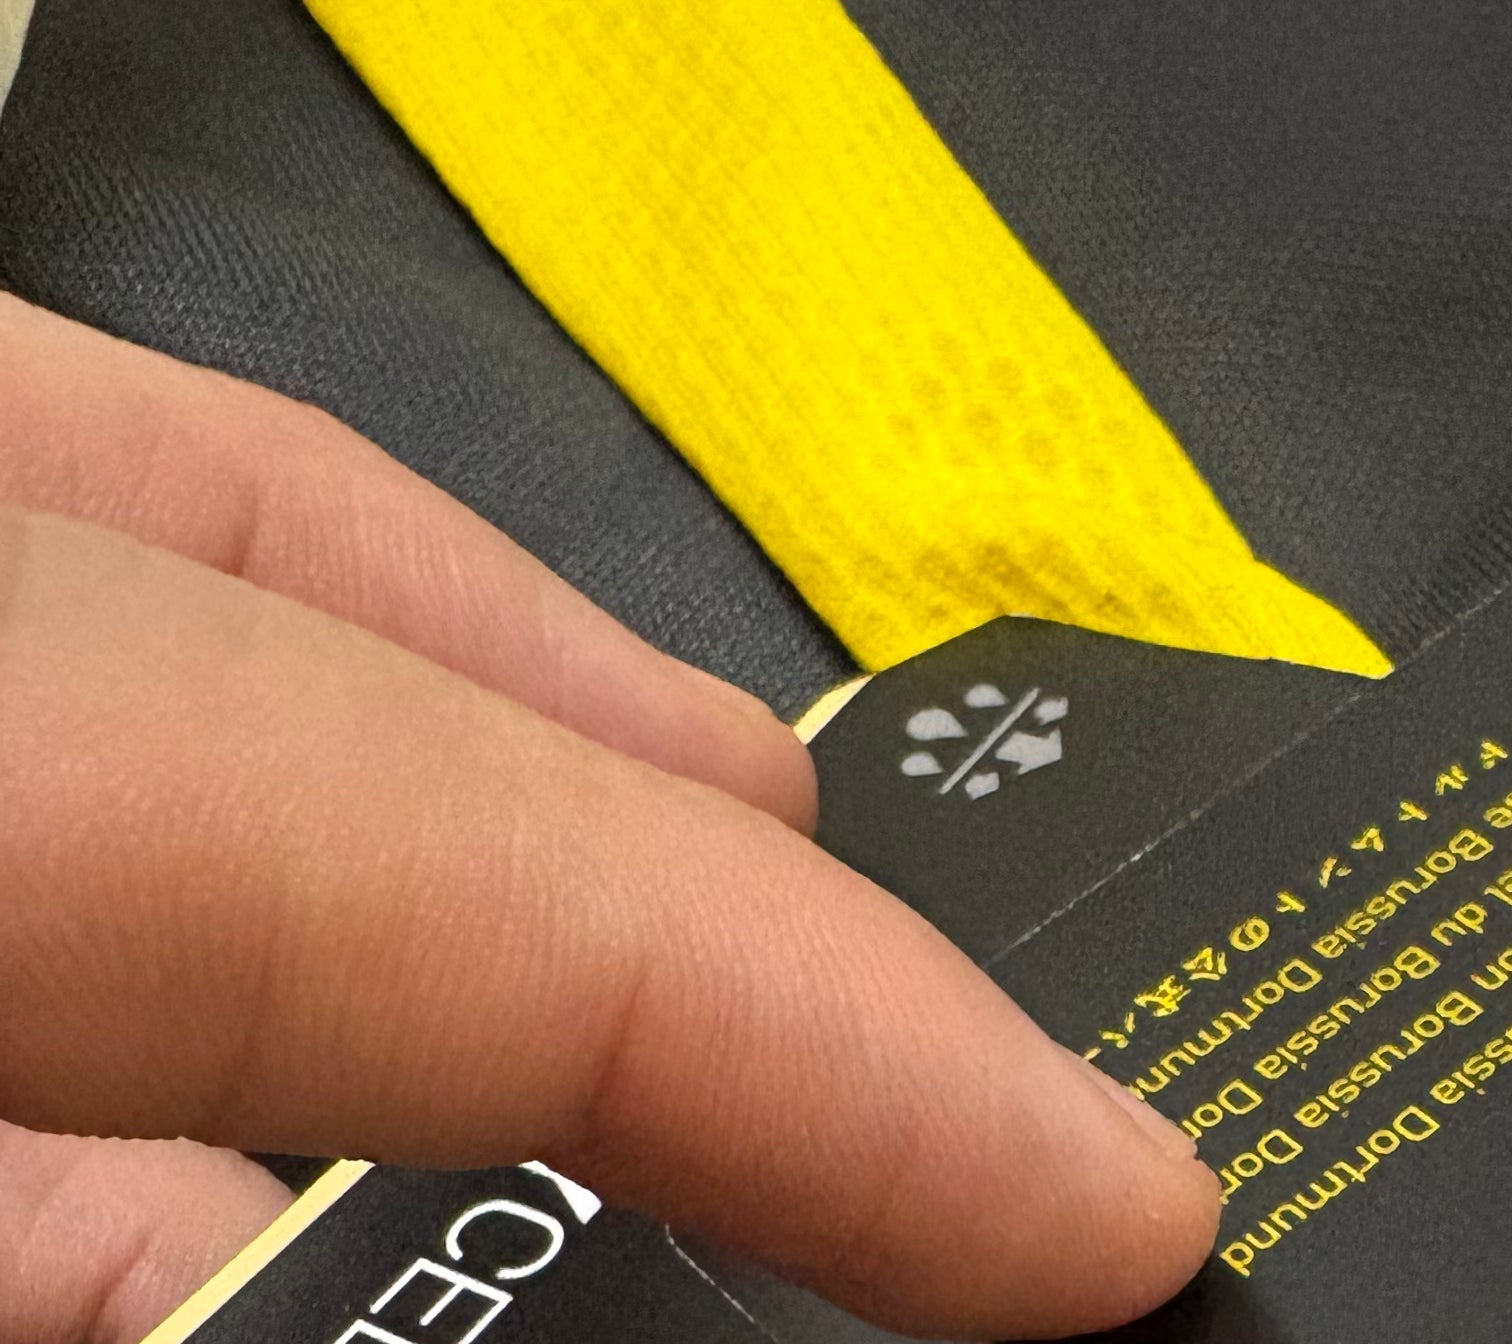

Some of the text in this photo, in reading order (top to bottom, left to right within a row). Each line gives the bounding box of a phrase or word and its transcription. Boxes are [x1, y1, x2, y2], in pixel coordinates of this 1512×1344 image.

[1310, 828, 1494, 959] Borussia
[1430, 901, 1488, 947] du
[1253, 945, 1441, 1080] Borussia
[1294, 990, 1485, 1129] Borussia
[1220, 1104, 1441, 1277] Dortmund
